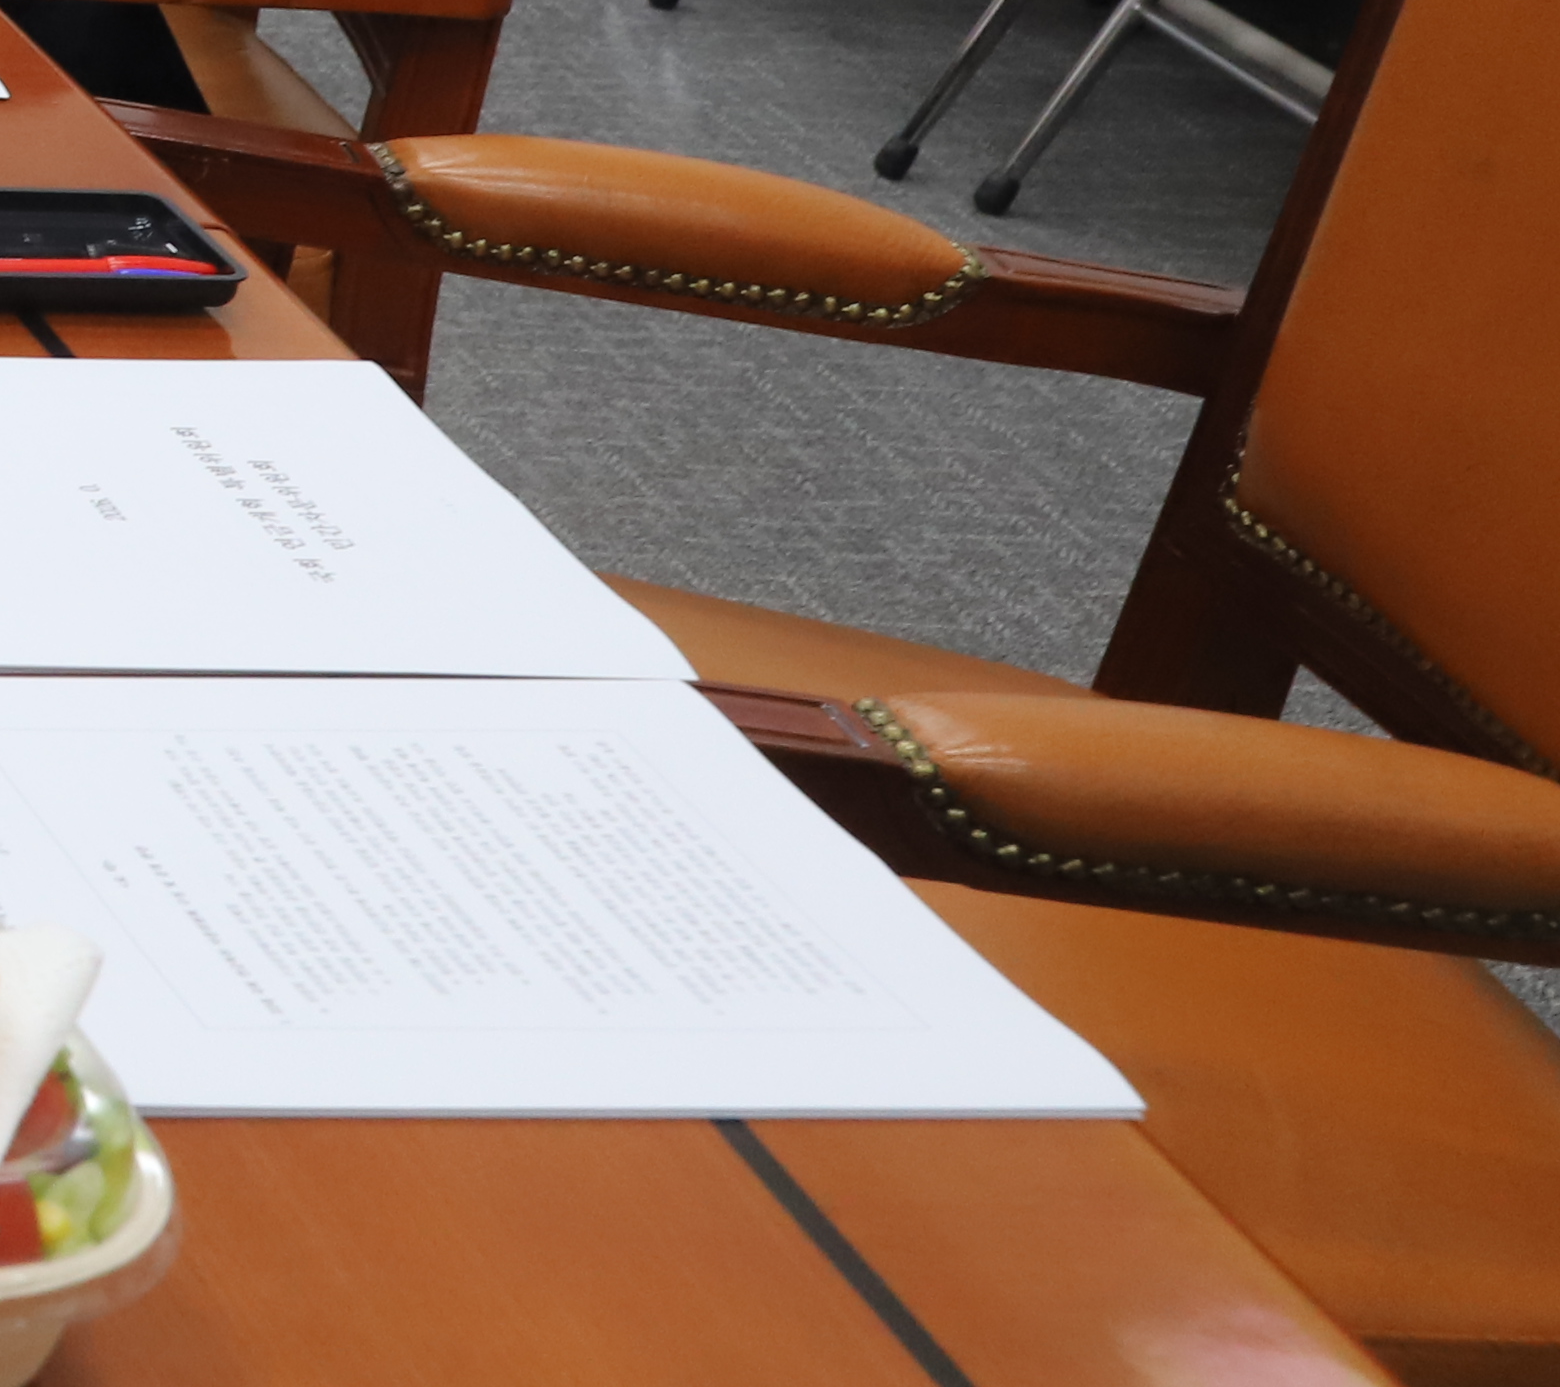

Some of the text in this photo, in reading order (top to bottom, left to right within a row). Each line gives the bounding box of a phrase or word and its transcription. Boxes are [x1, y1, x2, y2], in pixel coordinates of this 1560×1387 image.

[166, 425, 255, 490] 특별위원회
[243, 458, 361, 550] 민간자문위원회
[291, 557, 343, 583] 국회
